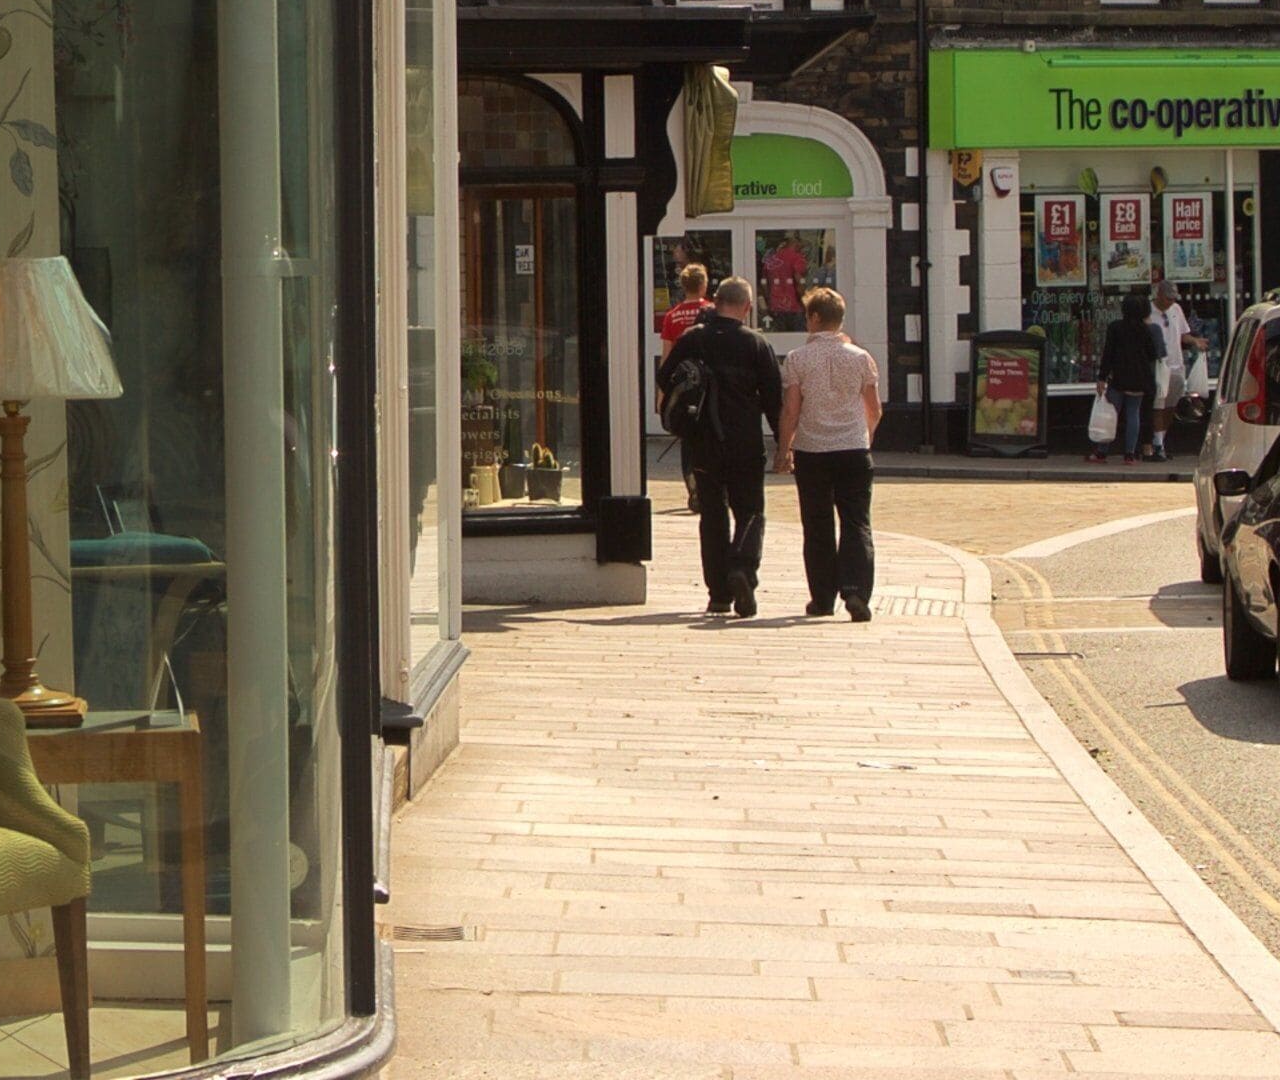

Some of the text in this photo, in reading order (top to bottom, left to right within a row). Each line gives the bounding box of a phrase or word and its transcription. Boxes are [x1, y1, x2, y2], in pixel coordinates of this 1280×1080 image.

[1049, 88, 1102, 131] The
[791, 179, 823, 196] food
[1051, 204, 1070, 224] £1
[1115, 202, 1136, 223] £8
[1175, 201, 1201, 218] Half
[1051, 224, 1070, 236] Each
[1115, 222, 1136, 233] Each
[1175, 219, 1201, 232] price
[1032, 289, 1104, 308] Open every day
